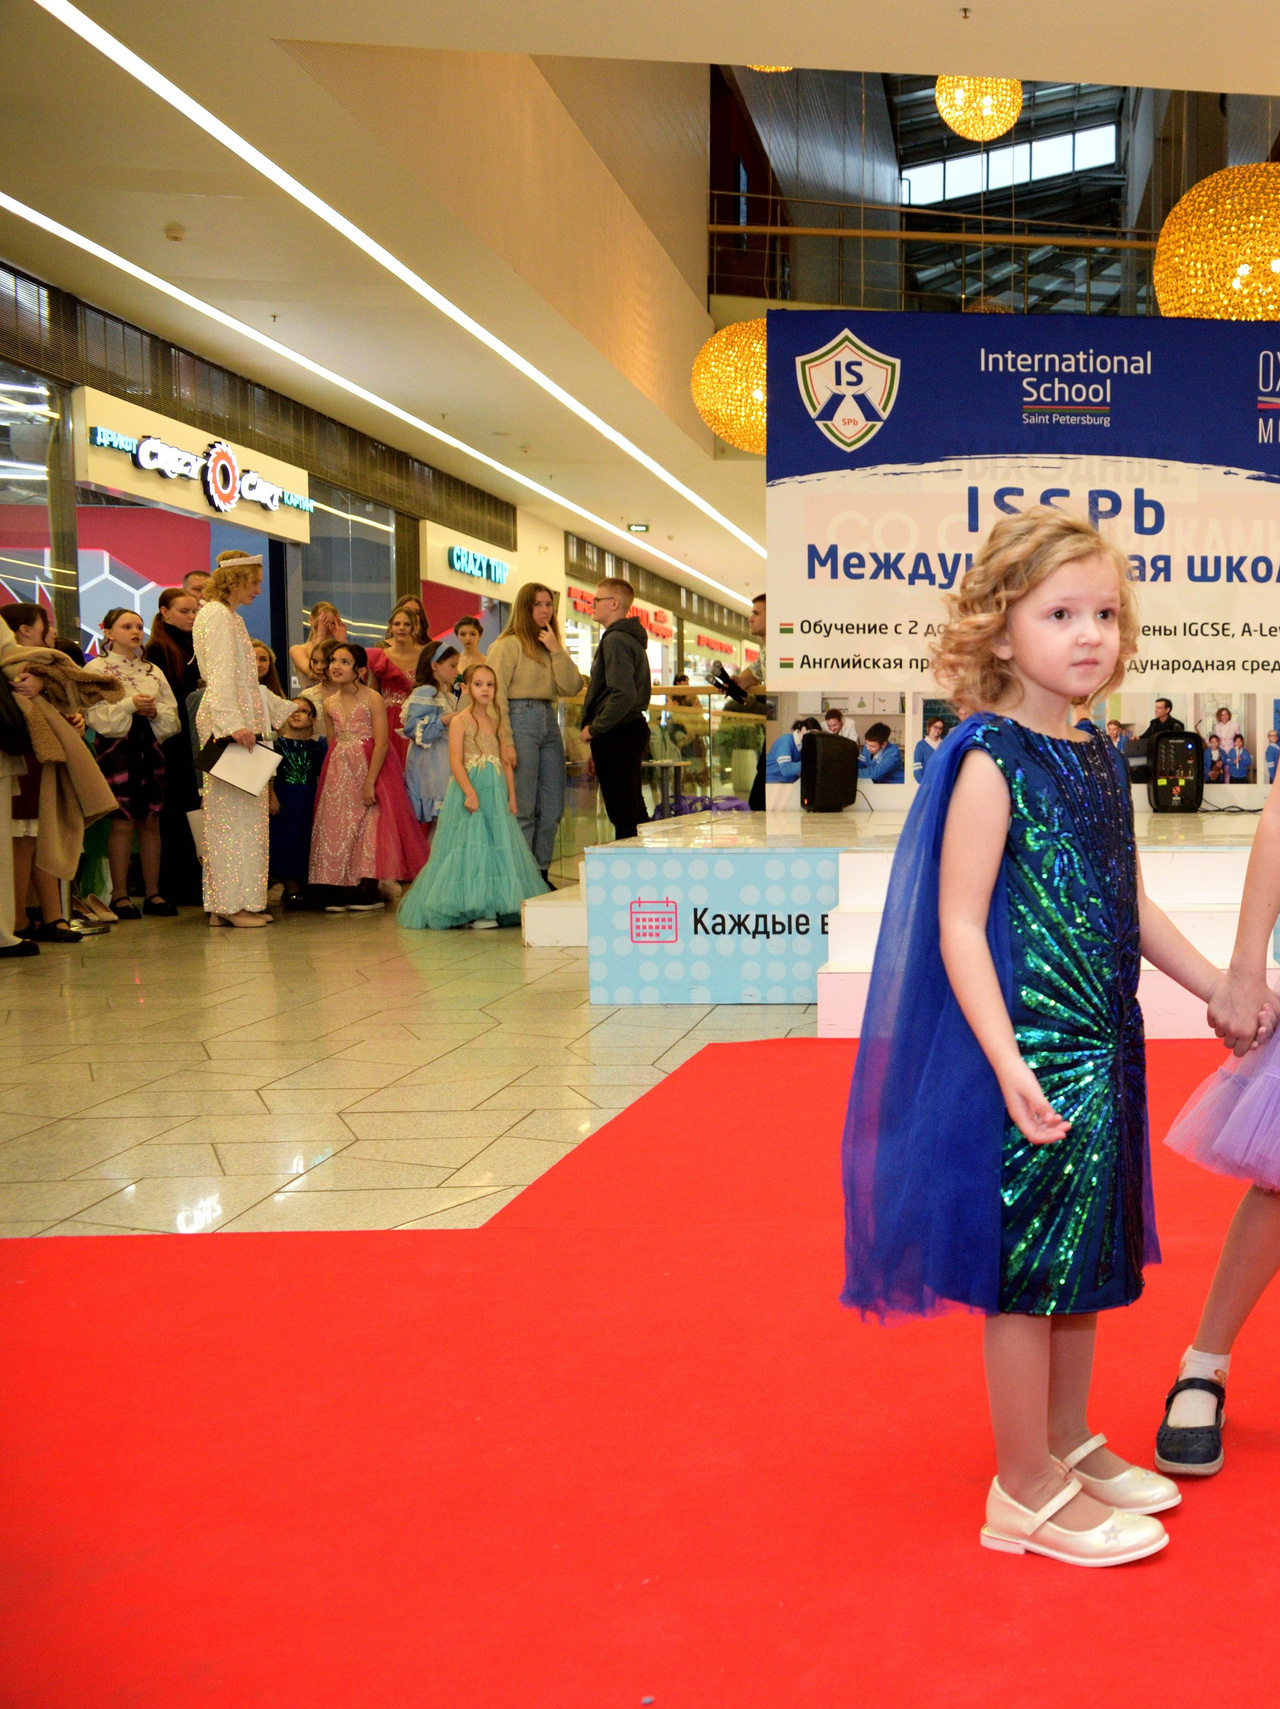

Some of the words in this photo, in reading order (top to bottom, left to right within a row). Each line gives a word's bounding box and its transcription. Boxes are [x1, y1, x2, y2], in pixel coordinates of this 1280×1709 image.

[834, 360, 864, 387] IS
[979, 347, 1152, 375] International
[1022, 377, 1111, 403] School
[841, 418, 859, 426] SPb
[1022, 413, 1050, 425] Saint
[1052, 413, 1111, 428] Petersburg
[95, 426, 138, 455] ДРИФТ
[452, 544, 488, 580] CRAZY
[488, 556, 509, 585] ТИР
[799, 619, 889, 638] Обучение
[893, 624, 902, 635] с
[907, 619, 919, 635] 2
[1182, 622, 1236, 639] IGCSE,
[799, 654, 903, 671] Английская
[692, 907, 811, 940] Каждые
